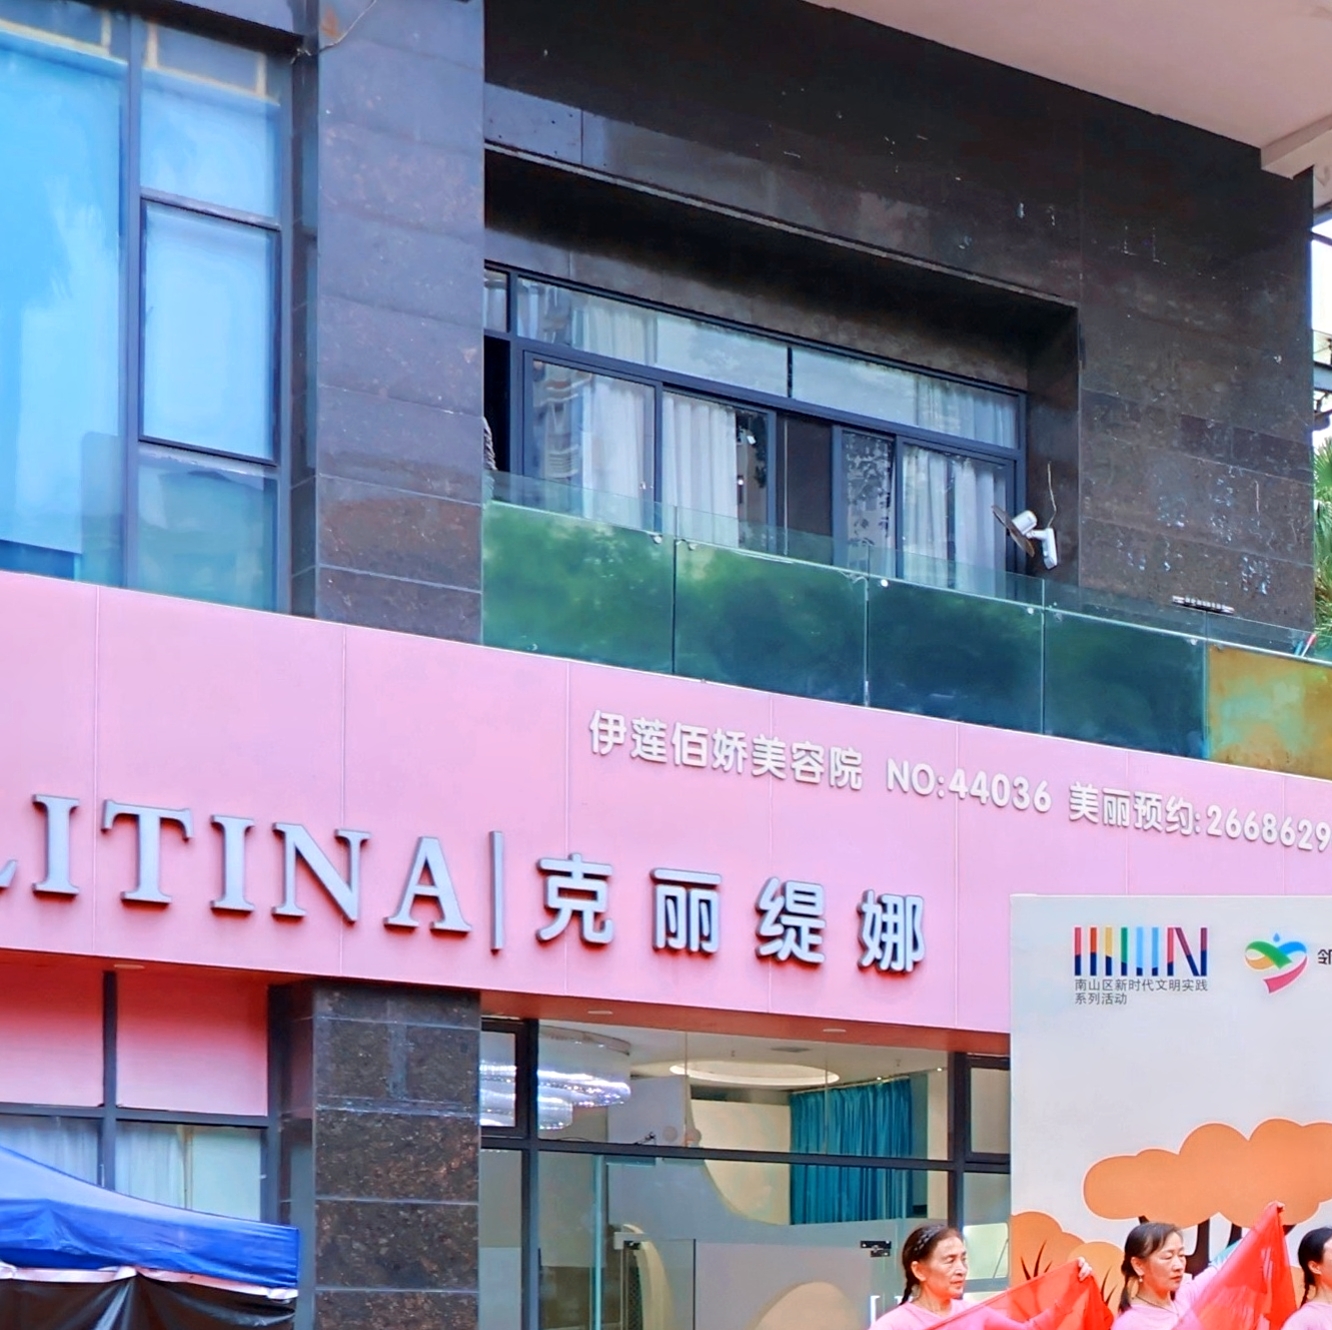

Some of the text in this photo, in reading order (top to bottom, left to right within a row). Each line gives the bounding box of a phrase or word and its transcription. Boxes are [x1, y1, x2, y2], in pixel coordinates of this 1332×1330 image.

[589, 709, 863, 791] 伊莲佰娇美容院
[886, 757, 1052, 813] NO:44036
[0, 793, 926, 973] ITINA 克丽缇娜
[1074, 978, 1208, 992] 南山区新时代文明实践
[1074, 993, 1127, 1006] 系列活动
